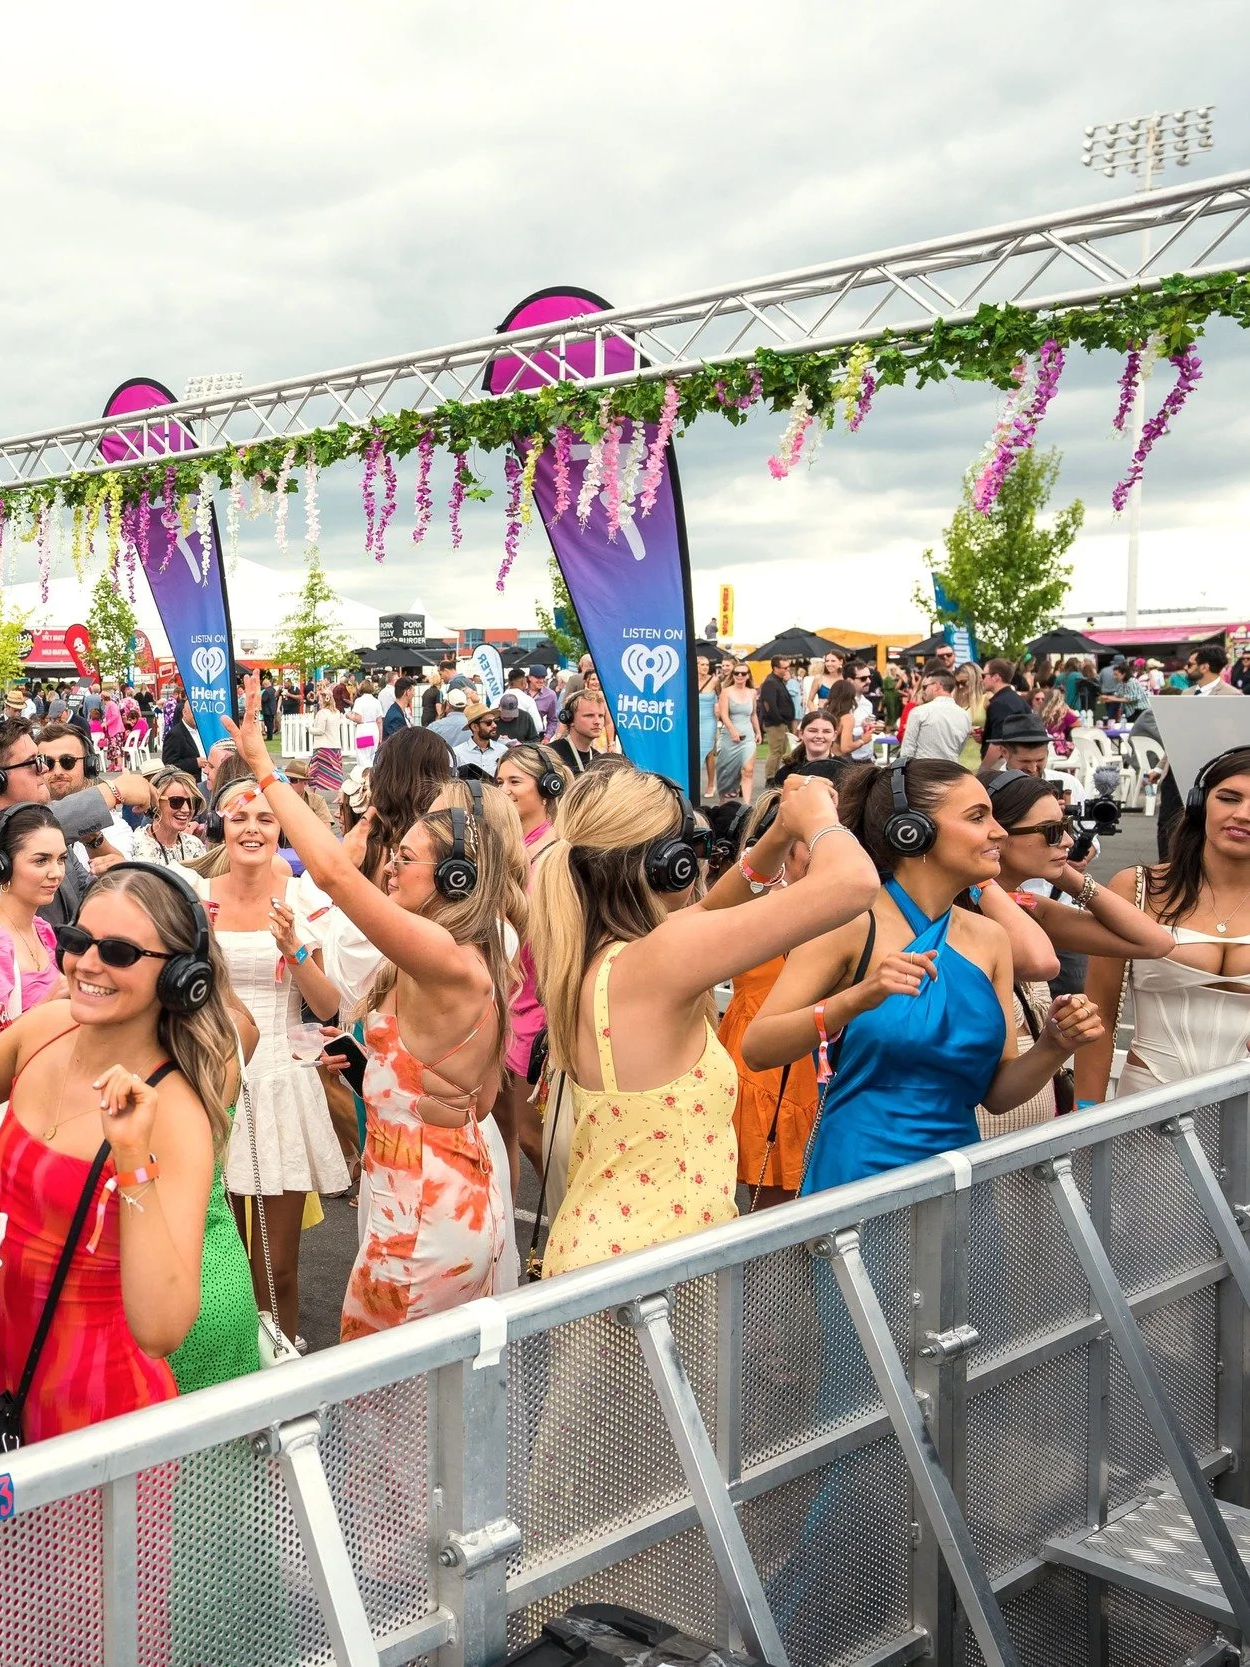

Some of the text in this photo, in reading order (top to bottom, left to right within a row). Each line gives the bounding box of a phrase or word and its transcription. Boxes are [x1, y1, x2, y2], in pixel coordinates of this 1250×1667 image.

[403, 621, 423, 629] PORK
[190, 634, 226, 643] LISTEN ON
[402, 629, 424, 637] BELLY
[622, 628, 683, 640] LISTEN ON
[398, 637, 426, 645] BURGER
[617, 693, 675, 716] iHeart
[617, 714, 673, 733] RADIO
[551, 780, 561, 790] G
[898, 824, 917, 844] G
[676, 858, 691, 879] G
[450, 871, 466, 887] G
[190, 979, 206, 1002] G
